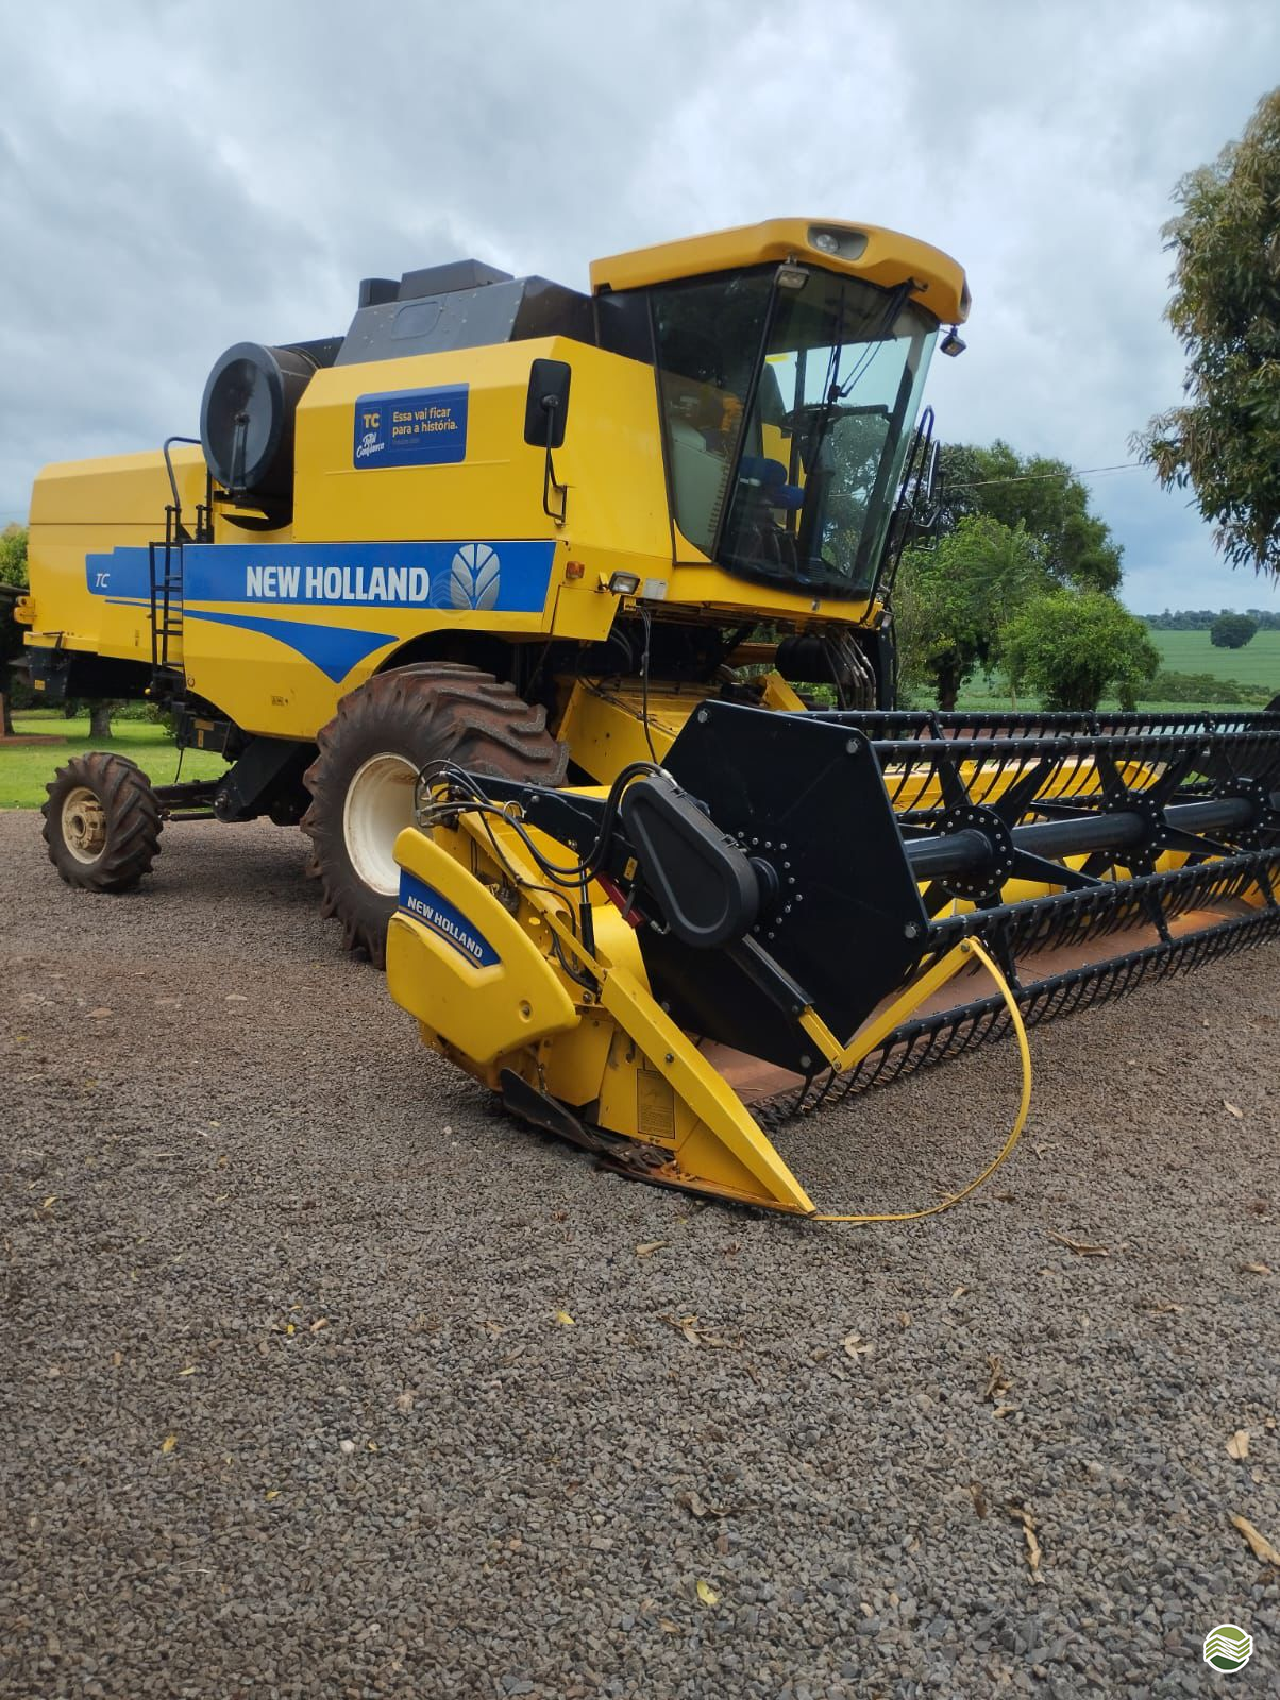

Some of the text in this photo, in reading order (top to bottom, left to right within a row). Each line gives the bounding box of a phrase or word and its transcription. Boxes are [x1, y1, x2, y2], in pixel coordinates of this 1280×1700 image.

[363, 413, 381, 428] TC
[392, 407, 452, 423] Essa vai ficar
[392, 419, 458, 437] para a história.
[95, 572, 111, 588] TC
[246, 565, 429, 602] NEW HOLLAND
[407, 896, 483, 958] NEW HOLLAND
